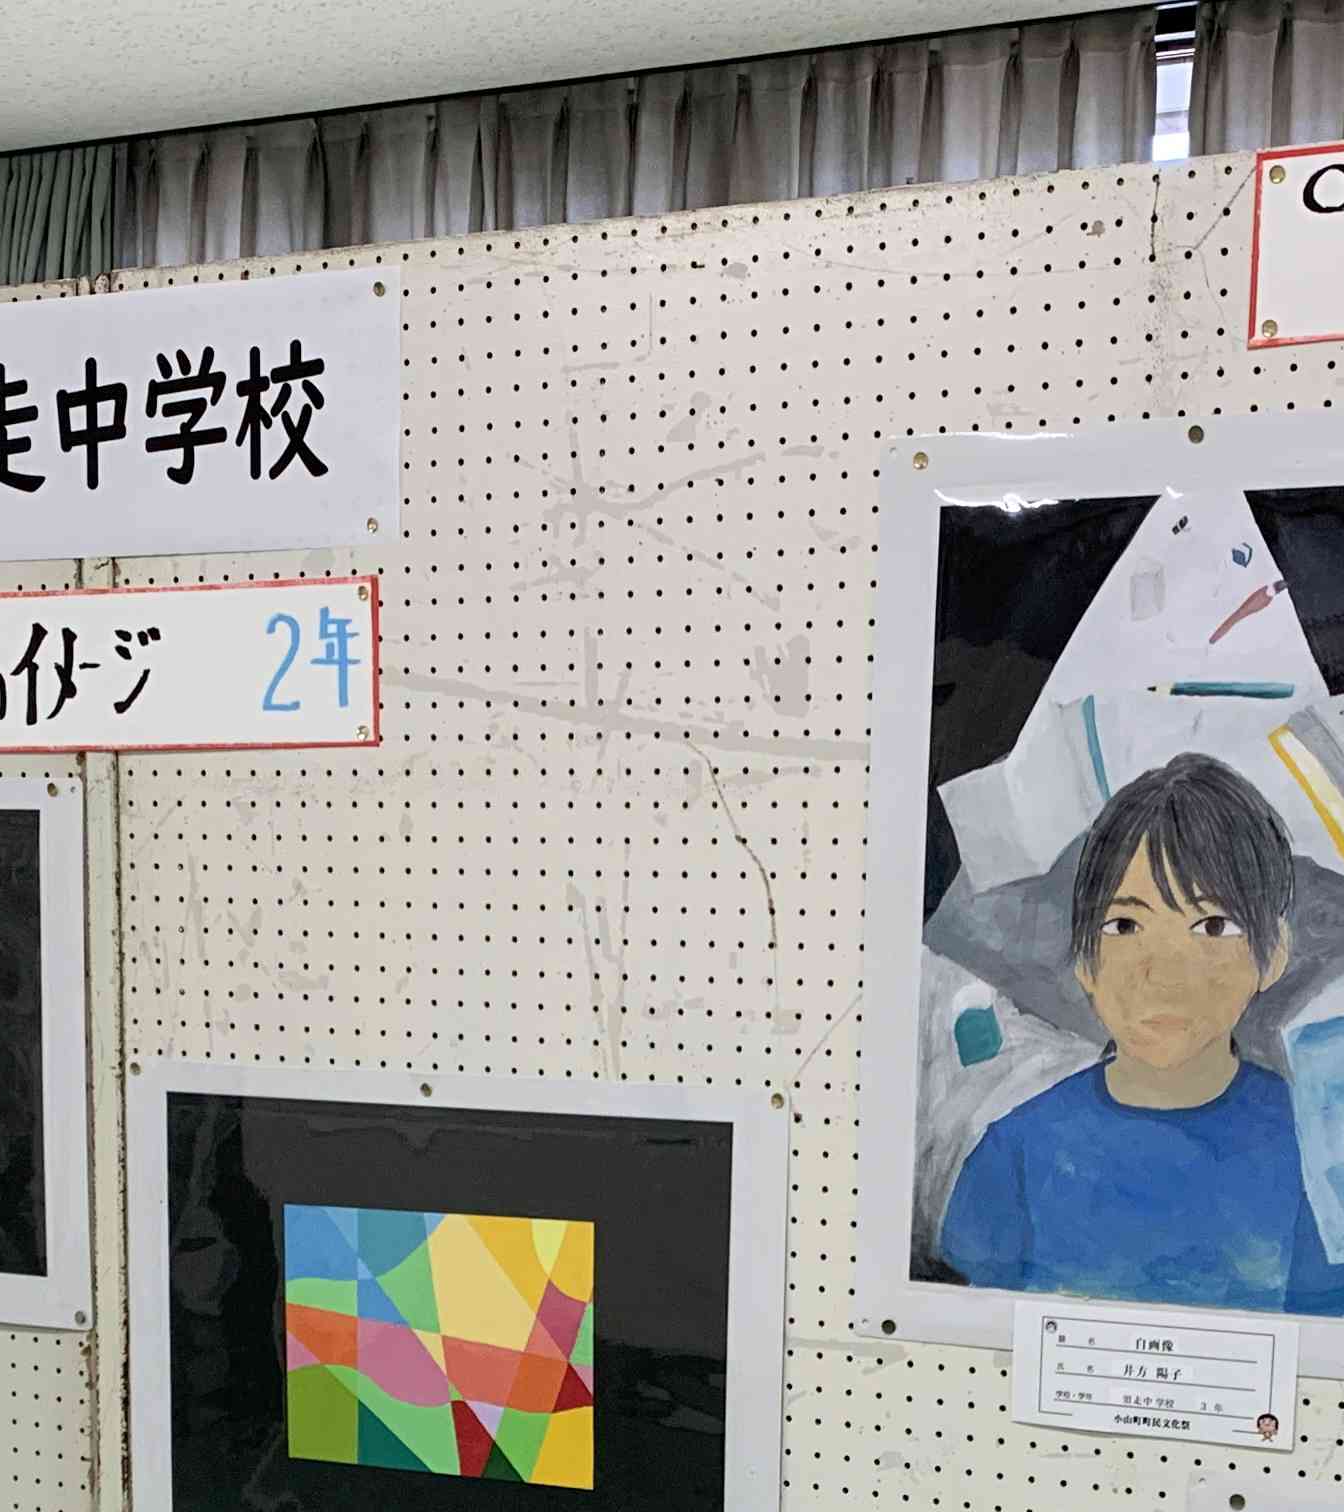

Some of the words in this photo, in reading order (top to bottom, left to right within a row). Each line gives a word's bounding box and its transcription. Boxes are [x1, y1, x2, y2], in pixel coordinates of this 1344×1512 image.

[262, 606, 361, 712] 2年
[1135, 1337, 1175, 1352] 自画像
[1114, 1414, 1191, 1431] 小山町町民文化祭
